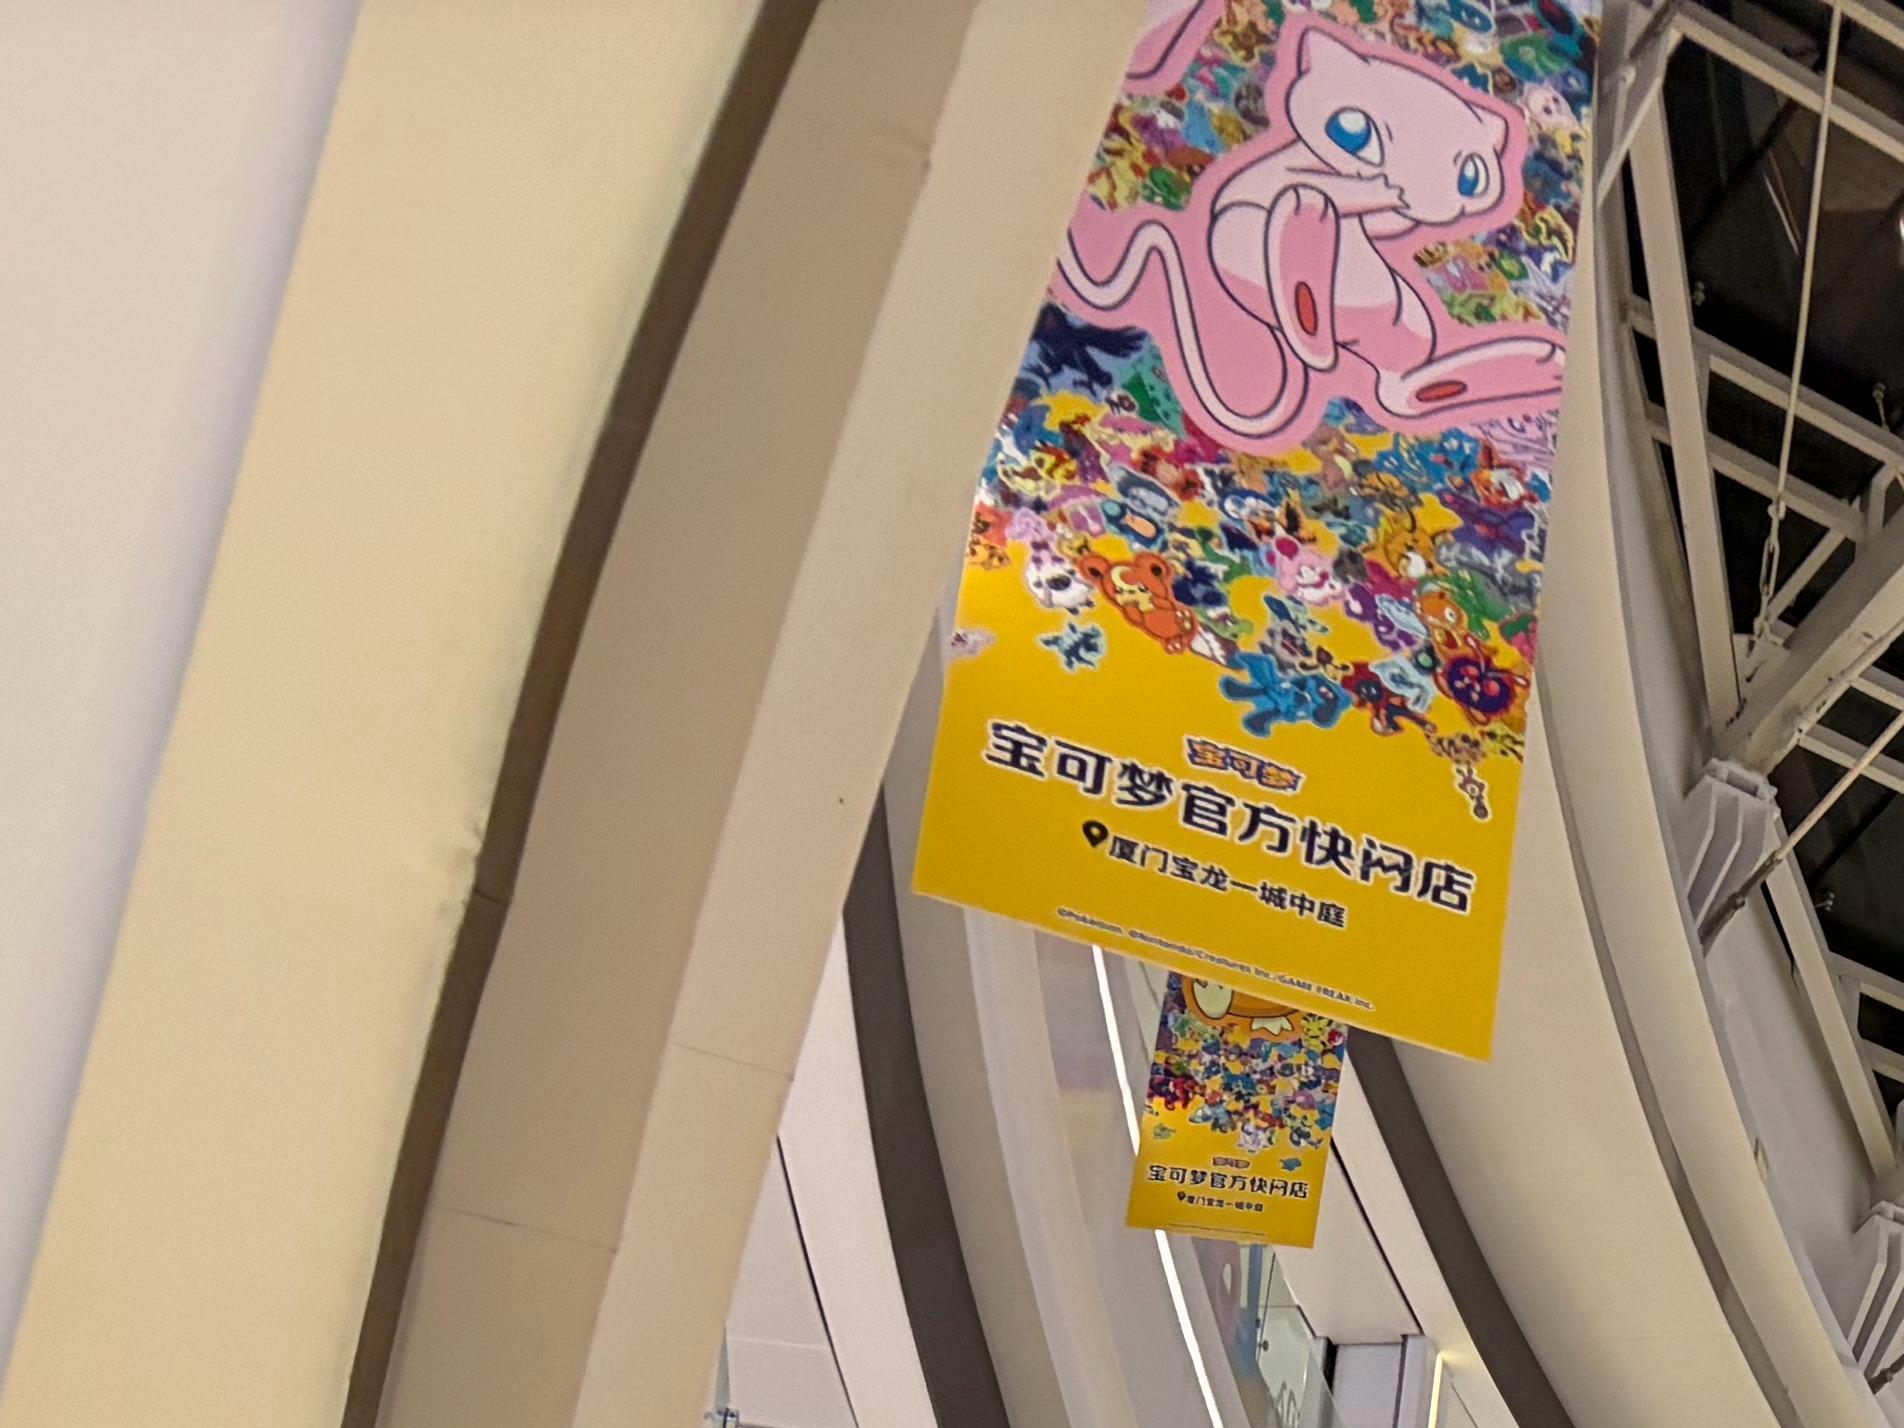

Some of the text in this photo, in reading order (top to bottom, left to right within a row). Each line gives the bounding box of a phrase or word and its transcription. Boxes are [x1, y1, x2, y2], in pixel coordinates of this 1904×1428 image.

[1184, 735, 1303, 793] 宝可梦
[984, 719, 1475, 913] 宝可梦官方快闪店
[1108, 836, 1347, 929] 厦门宝龙一城中庭
[1148, 1164, 1308, 1199] 宝可梦官方快闪店
